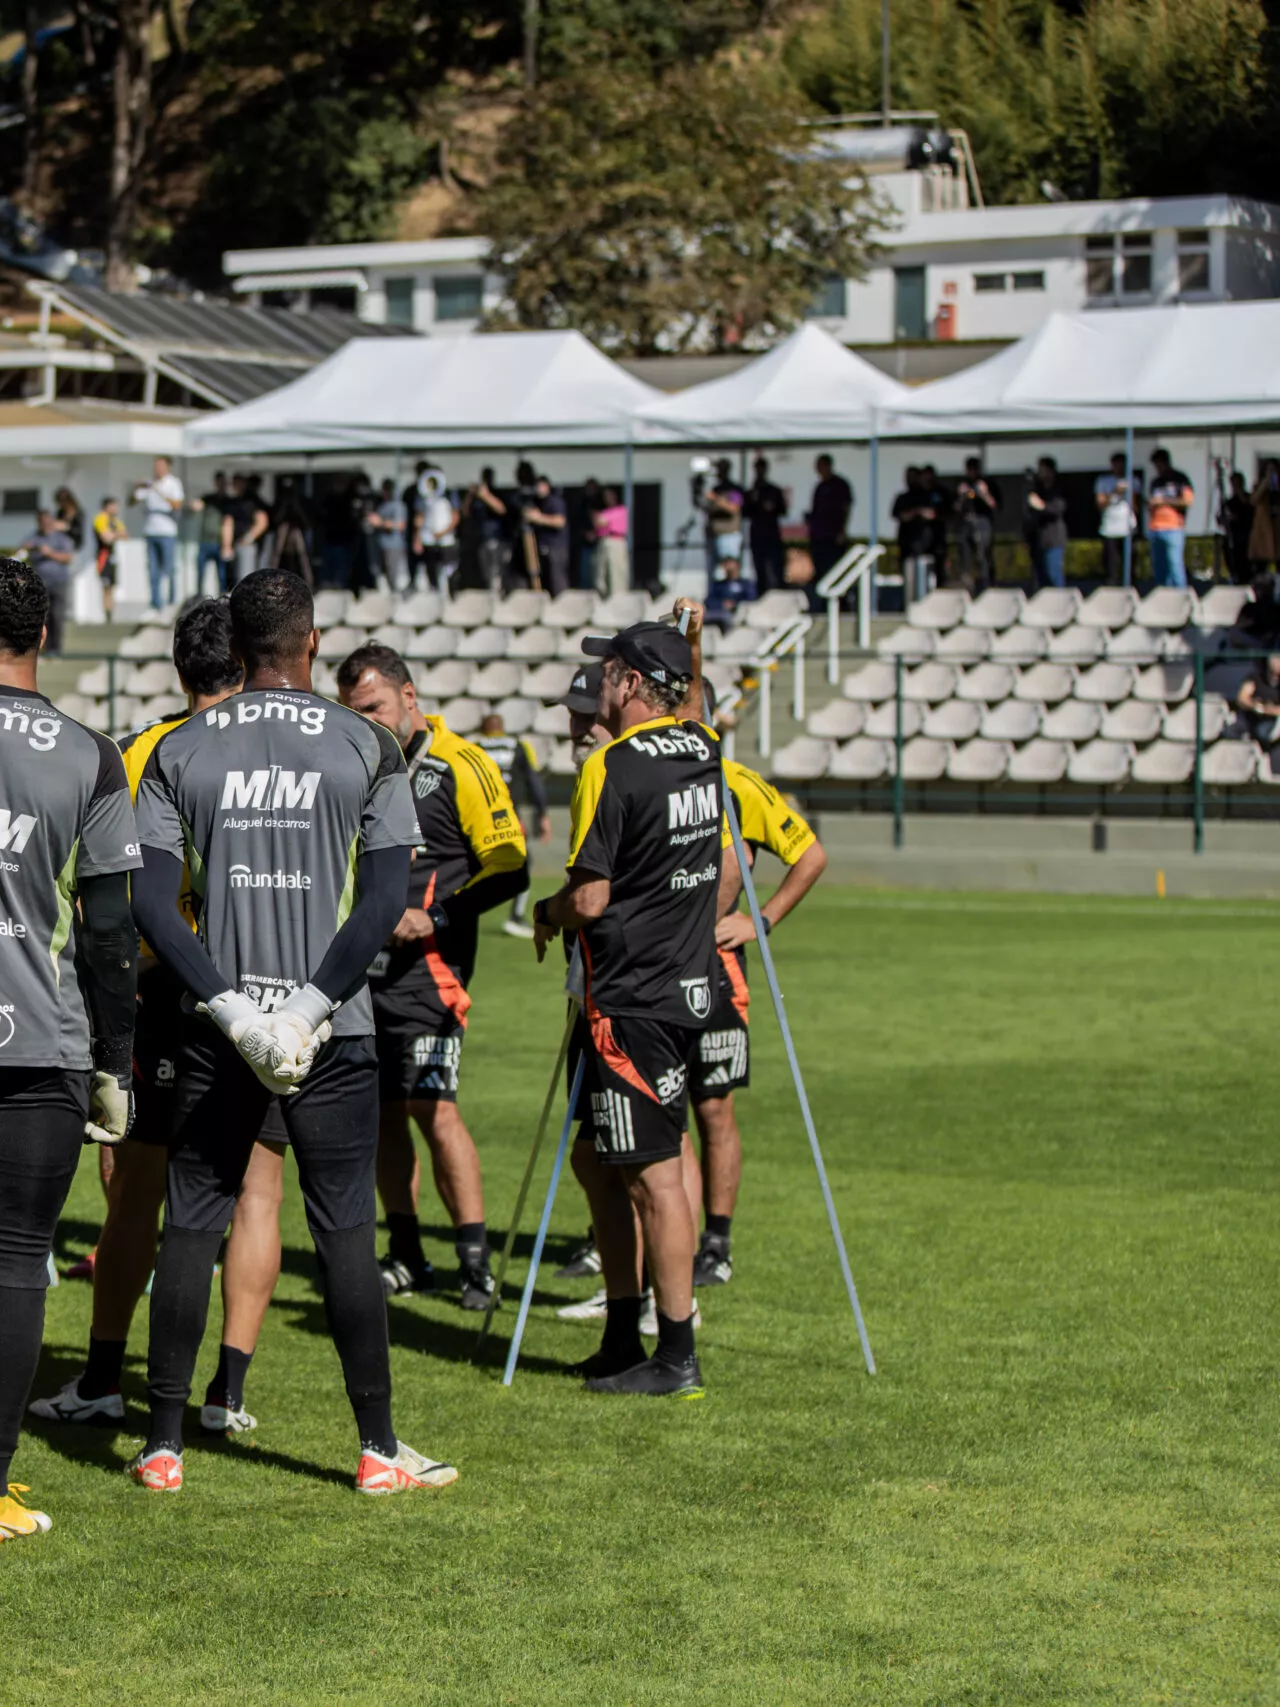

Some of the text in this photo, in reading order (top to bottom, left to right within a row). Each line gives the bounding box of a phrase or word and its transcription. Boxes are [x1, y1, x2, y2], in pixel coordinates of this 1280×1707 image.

[13, 701, 58, 717] banco
[237, 701, 328, 735] bmg
[221, 765, 321, 811] MM
[223, 816, 263, 831] Aluguel
[277, 818, 311, 829] carros
[229, 864, 312, 890] mundiale
